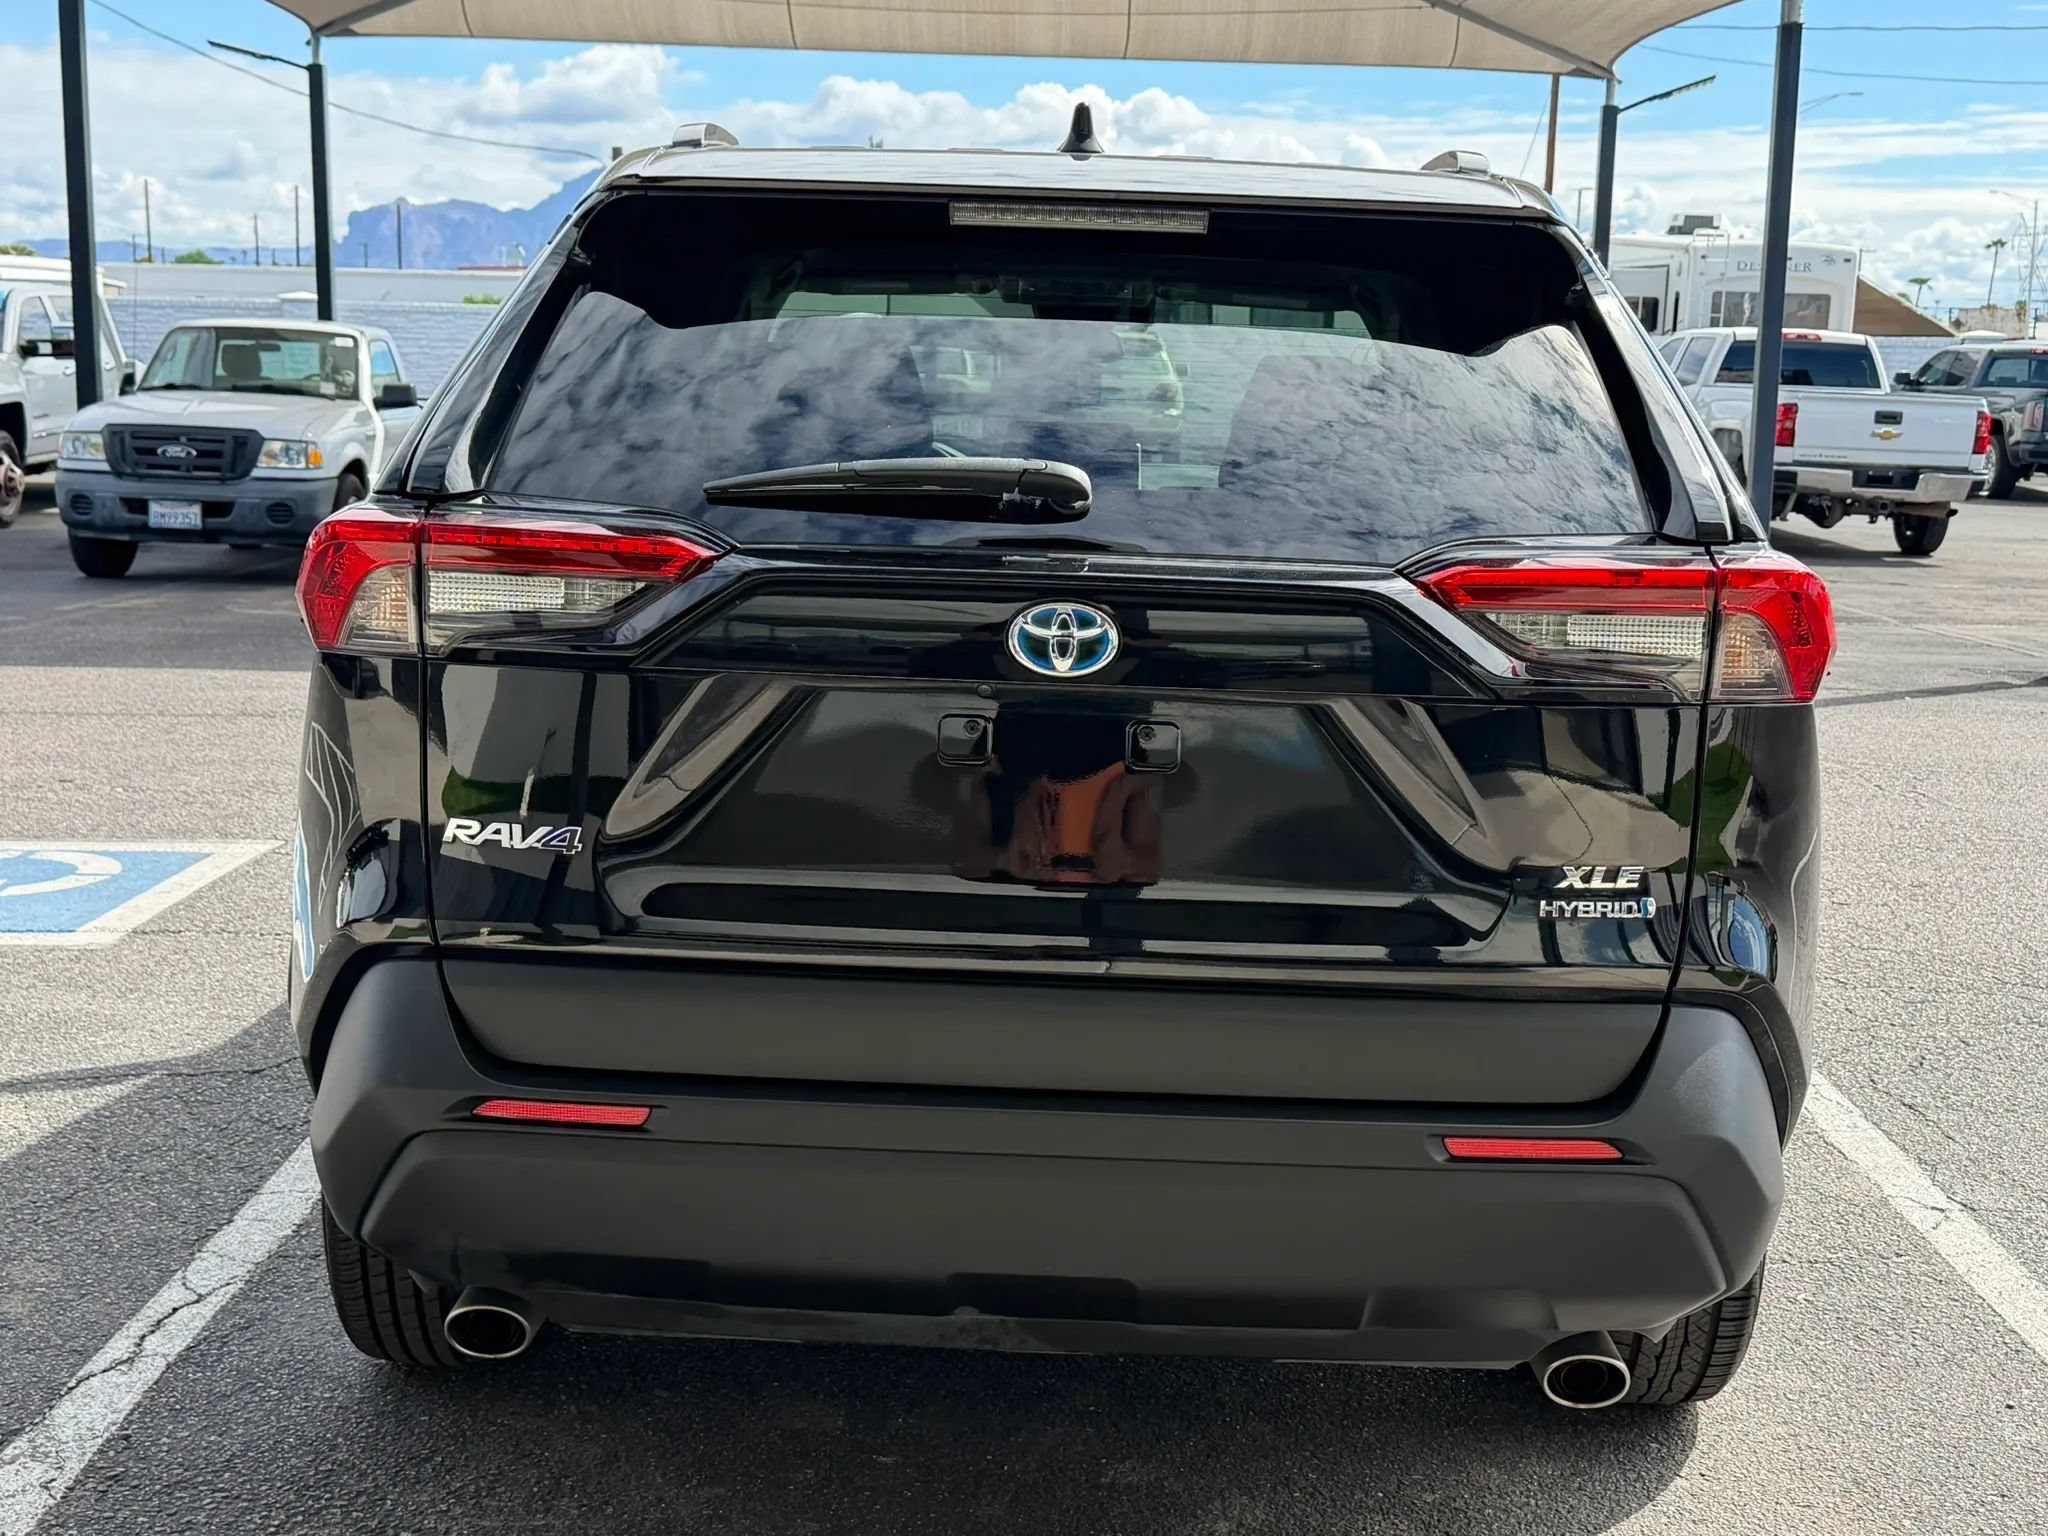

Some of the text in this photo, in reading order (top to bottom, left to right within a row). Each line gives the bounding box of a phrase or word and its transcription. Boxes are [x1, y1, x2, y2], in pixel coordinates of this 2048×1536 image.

[442, 817, 582, 854] RAV4
[1553, 866, 1644, 889] XLE
[1539, 899, 1639, 918] HYBRID
